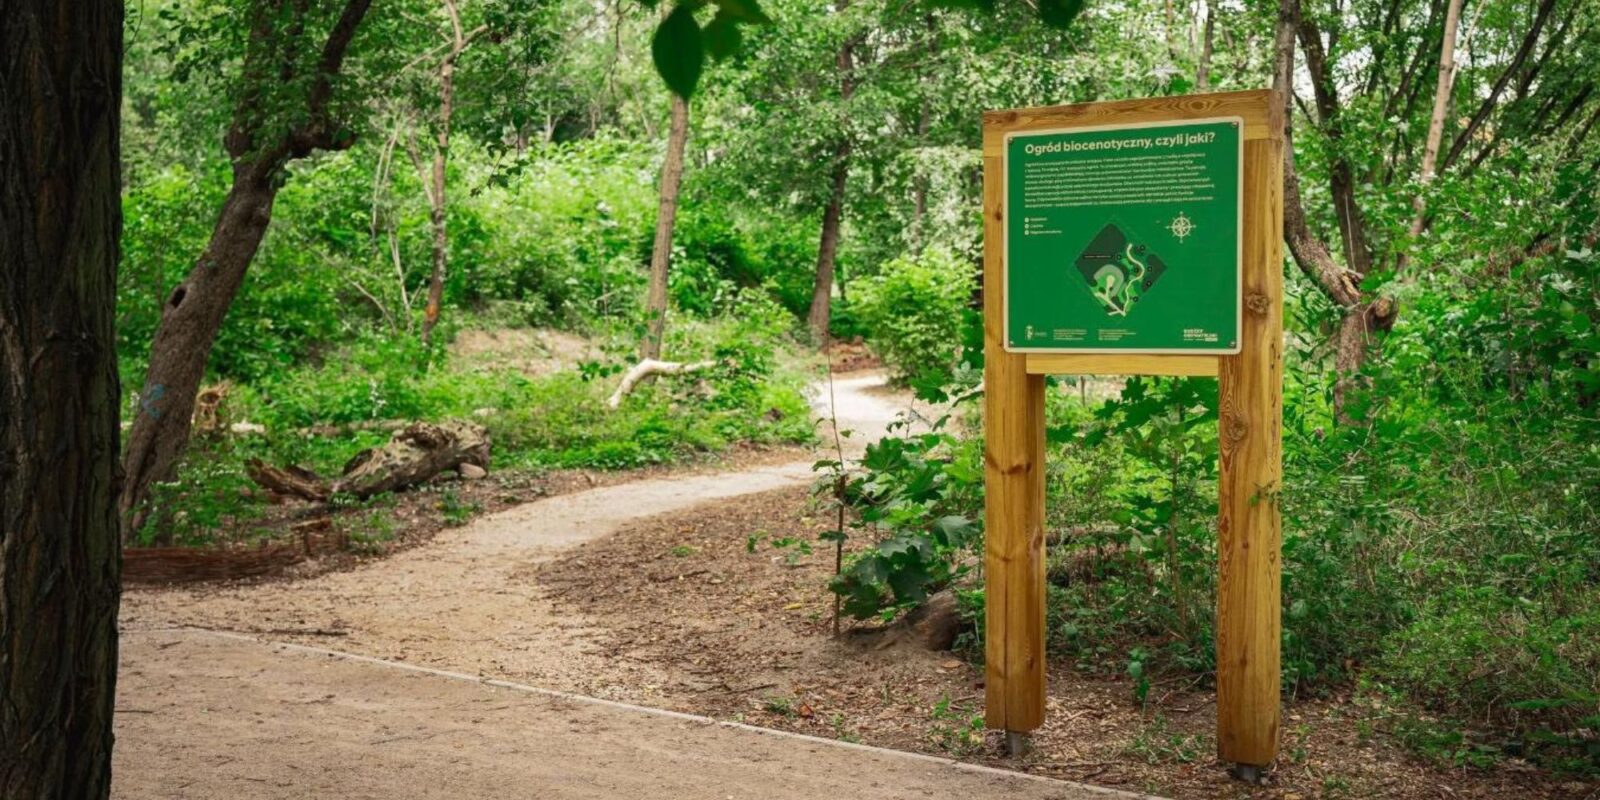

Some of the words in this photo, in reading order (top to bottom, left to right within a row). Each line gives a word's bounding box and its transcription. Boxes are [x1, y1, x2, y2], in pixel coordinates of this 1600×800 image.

[1025, 141, 1061, 156] Ogród
[1063, 138, 1153, 151] biocenotyczny,
[1155, 133, 1183, 147] czyli
[1185, 132, 1215, 146] jaki?
